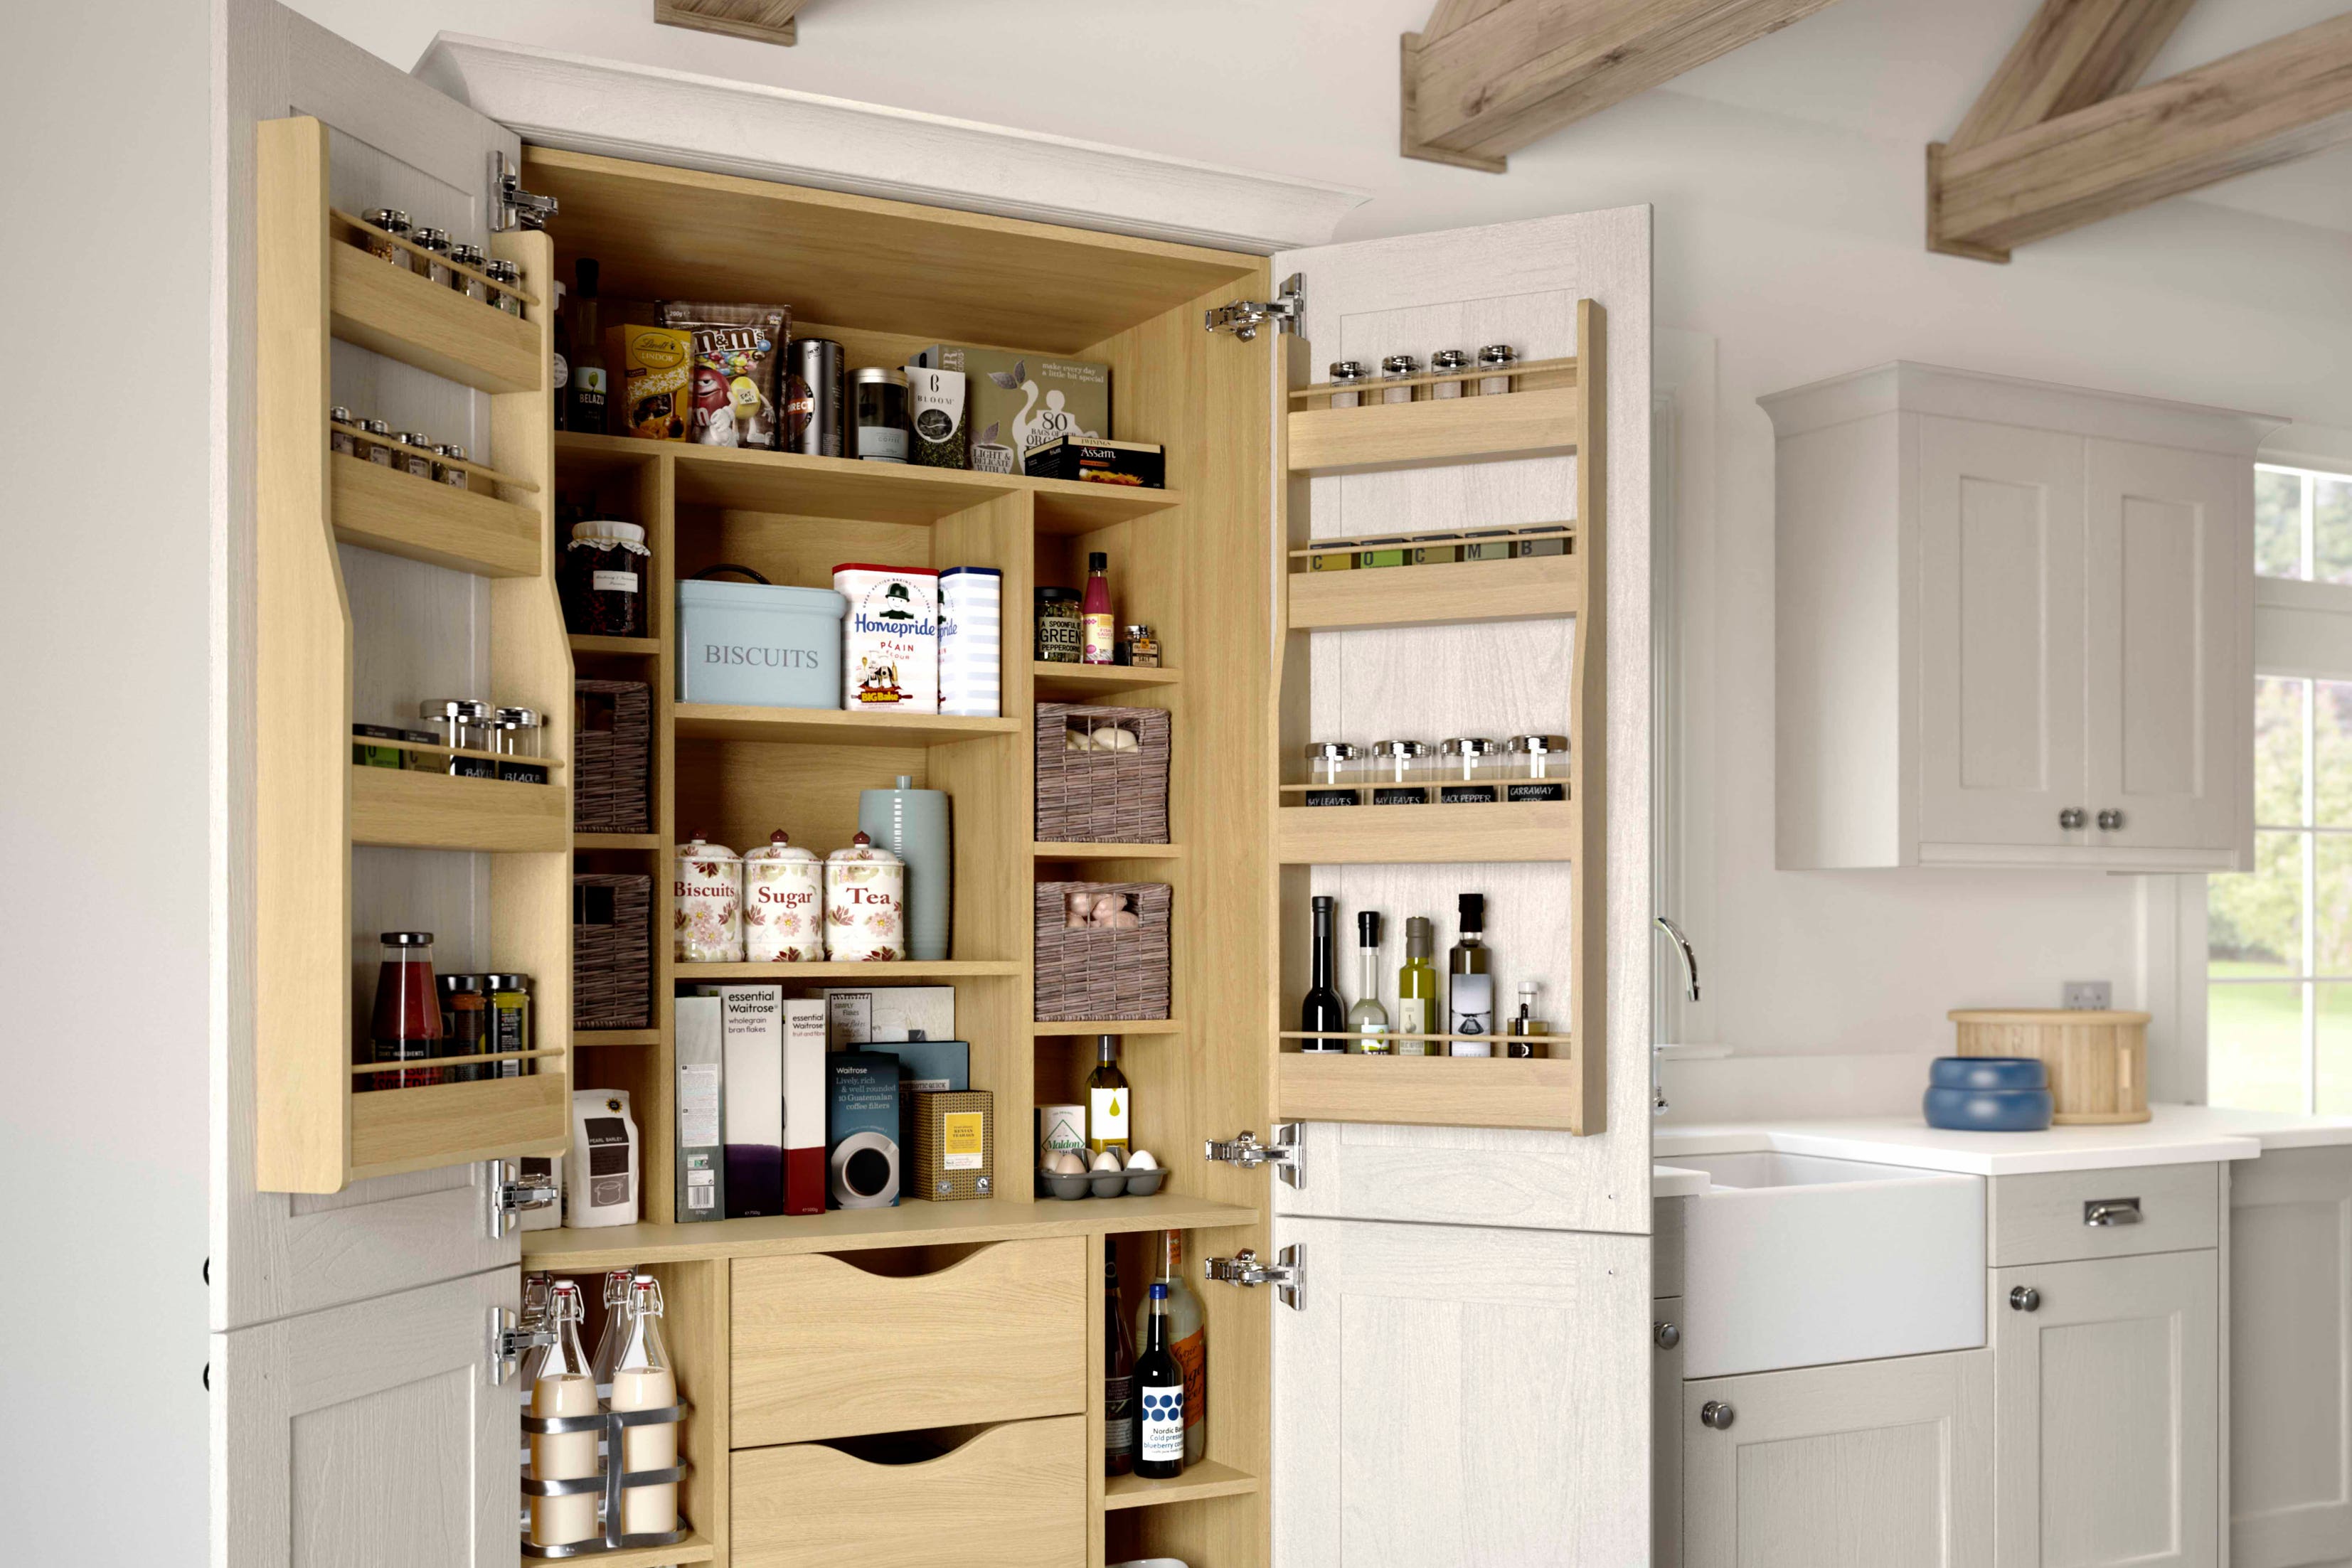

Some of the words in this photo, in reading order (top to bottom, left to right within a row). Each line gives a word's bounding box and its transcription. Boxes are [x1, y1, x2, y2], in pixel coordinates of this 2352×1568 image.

[642, 352, 674, 362] LINDOR
[1049, 370, 1065, 378] little
[1063, 366, 1082, 375] every
[1083, 367, 1095, 376] day
[580, 393, 604, 405] BELAZU
[917, 395, 952, 405] BLOOM
[787, 401, 811, 413] DIRECT
[1042, 412, 1068, 431] 80
[973, 449, 1003, 459] LIGHT
[1004, 452, 1011, 461] &
[1081, 447, 1116, 459] Assam
[974, 457, 1011, 467] DELICATE
[977, 465, 999, 474] WITH
[1468, 544, 1481, 558] M
[1521, 540, 1533, 555] B
[1415, 548, 1425, 562] C
[1313, 555, 1322, 570] C
[855, 613, 936, 638] Homepride
[1049, 621, 1076, 629] SPOONFUL
[1040, 629, 1081, 644] GREEN
[880, 640, 914, 652] PLAIN
[704, 644, 819, 668] BISCUITS
[886, 650, 910, 659] FLOUR
[465, 768, 484, 778] BAY
[504, 772, 533, 783] BLACK
[1511, 786, 1553, 795] CARRAWAY
[1308, 798, 1319, 806] BAY
[1460, 794, 1491, 803] PEPPER
[674, 881, 735, 897] Biscuits
[758, 886, 813, 909] Sugar
[846, 887, 891, 905] Tea
[728, 991, 775, 1002] essential
[728, 1003, 775, 1013] Waitrose
[728, 1017, 767, 1025] wholegrain
[836, 1077, 858, 1086] Lively,
[1047, 1140, 1080, 1150] Maldon
